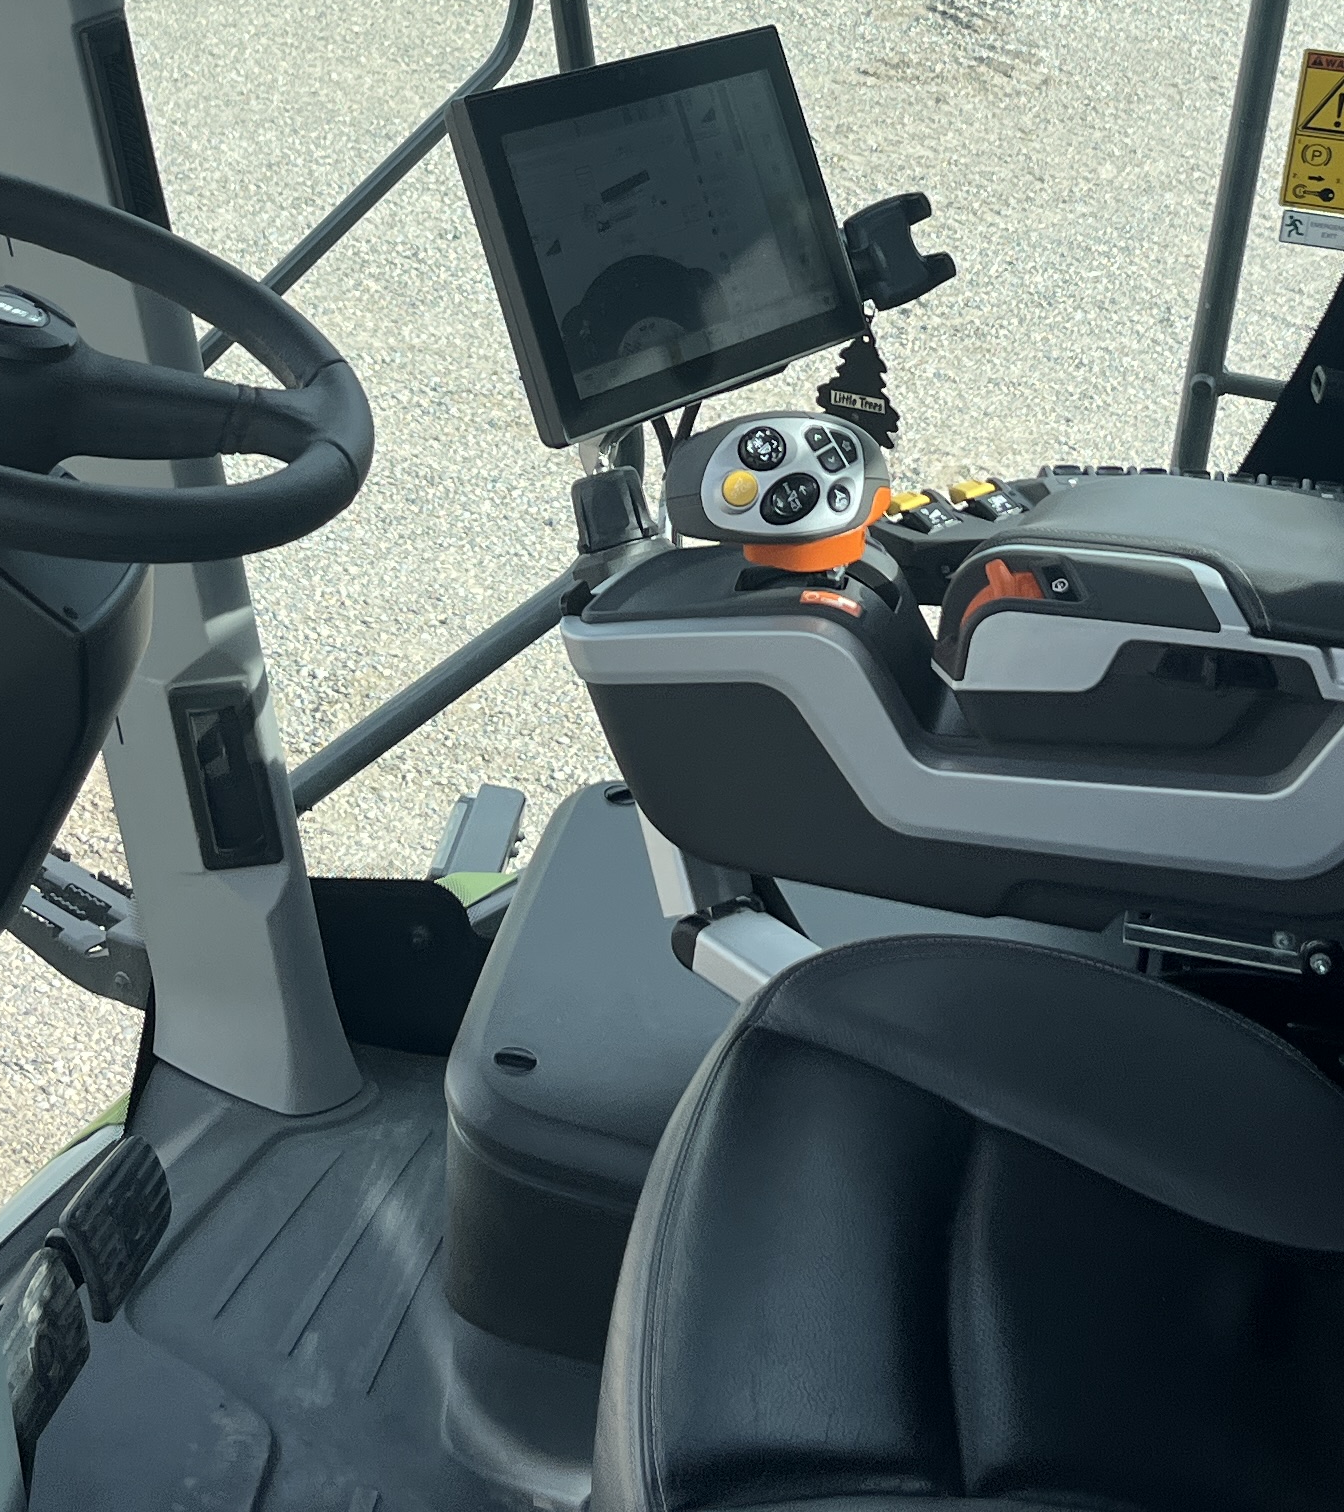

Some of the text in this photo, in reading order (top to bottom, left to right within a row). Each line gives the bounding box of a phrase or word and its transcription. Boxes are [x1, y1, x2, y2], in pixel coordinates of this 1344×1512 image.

[1320, 231, 1338, 239] EXIT
[833, 391, 884, 412] Little Trees
